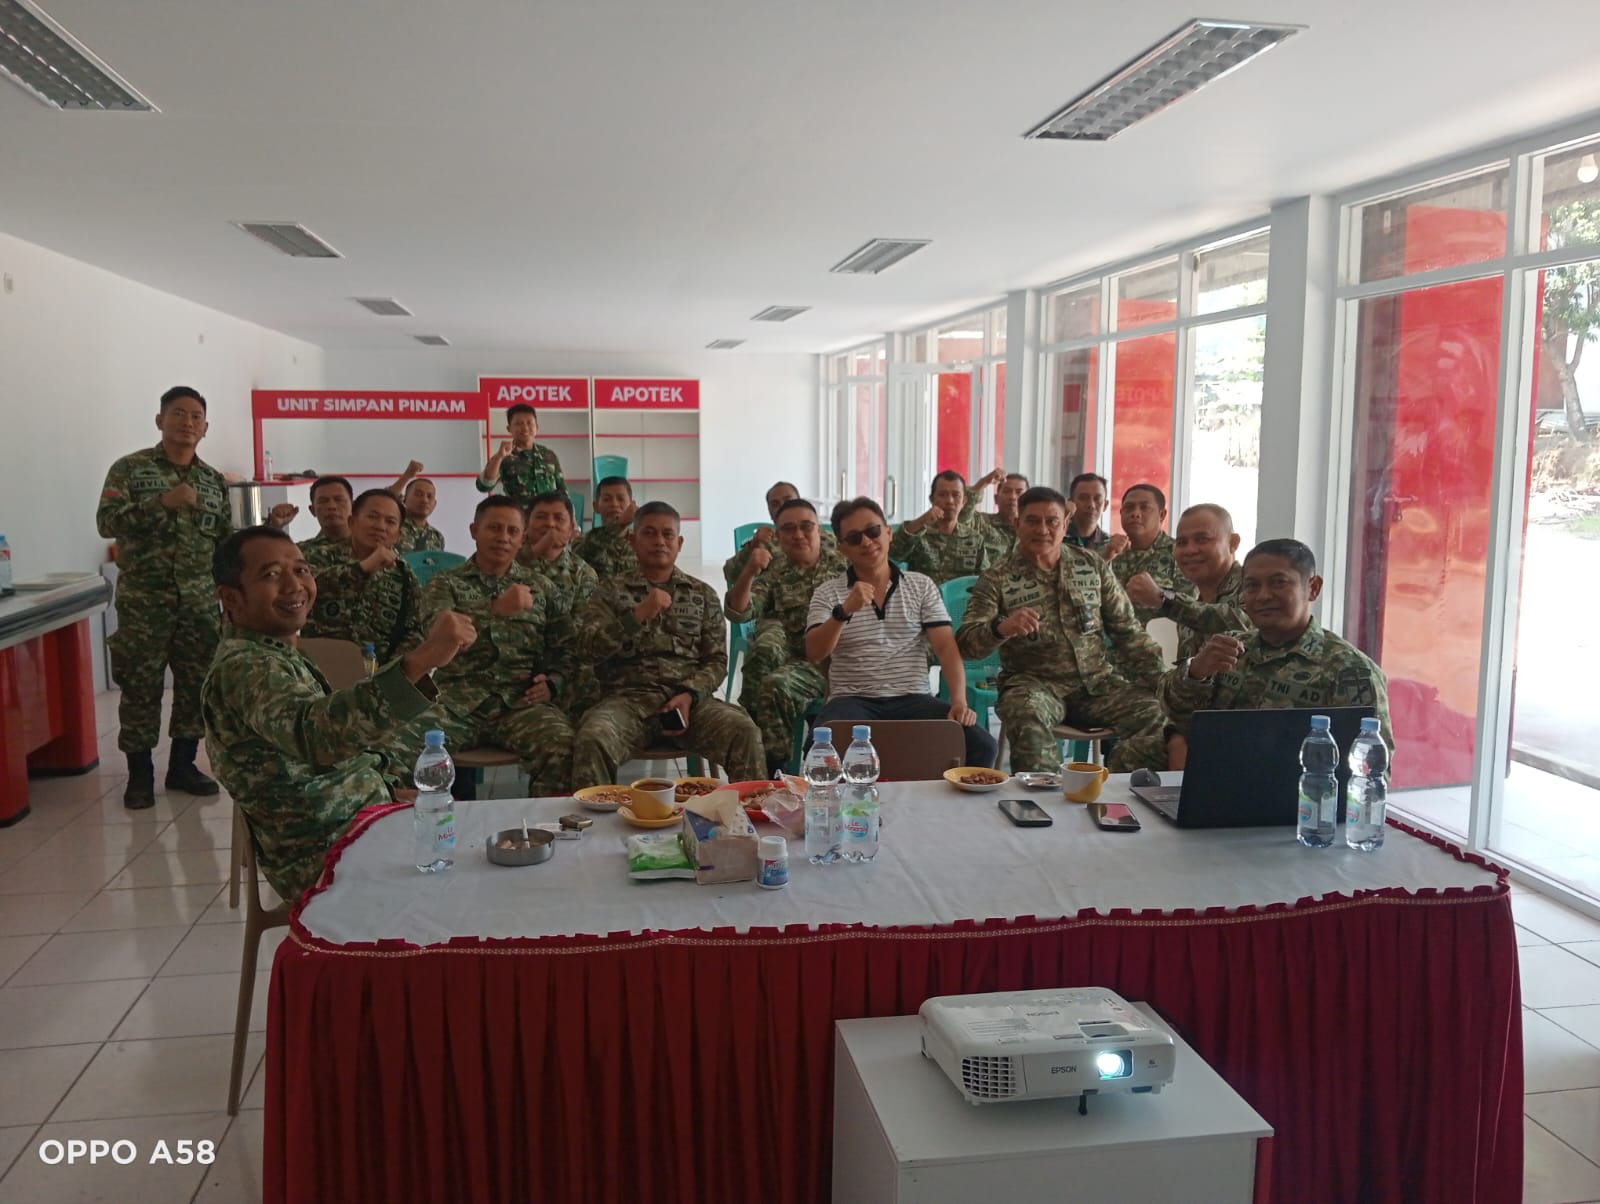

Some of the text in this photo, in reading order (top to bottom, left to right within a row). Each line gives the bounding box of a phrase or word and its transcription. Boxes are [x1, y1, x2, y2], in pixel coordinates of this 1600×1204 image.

[497, 386, 572, 401] APOTEK
[610, 387, 684, 402] APOTEK
[277, 398, 466, 413] UNIT SIMPAN PINJAM
[1271, 680, 1320, 701] TNI AD
[1051, 1066, 1077, 1074] EPSON
